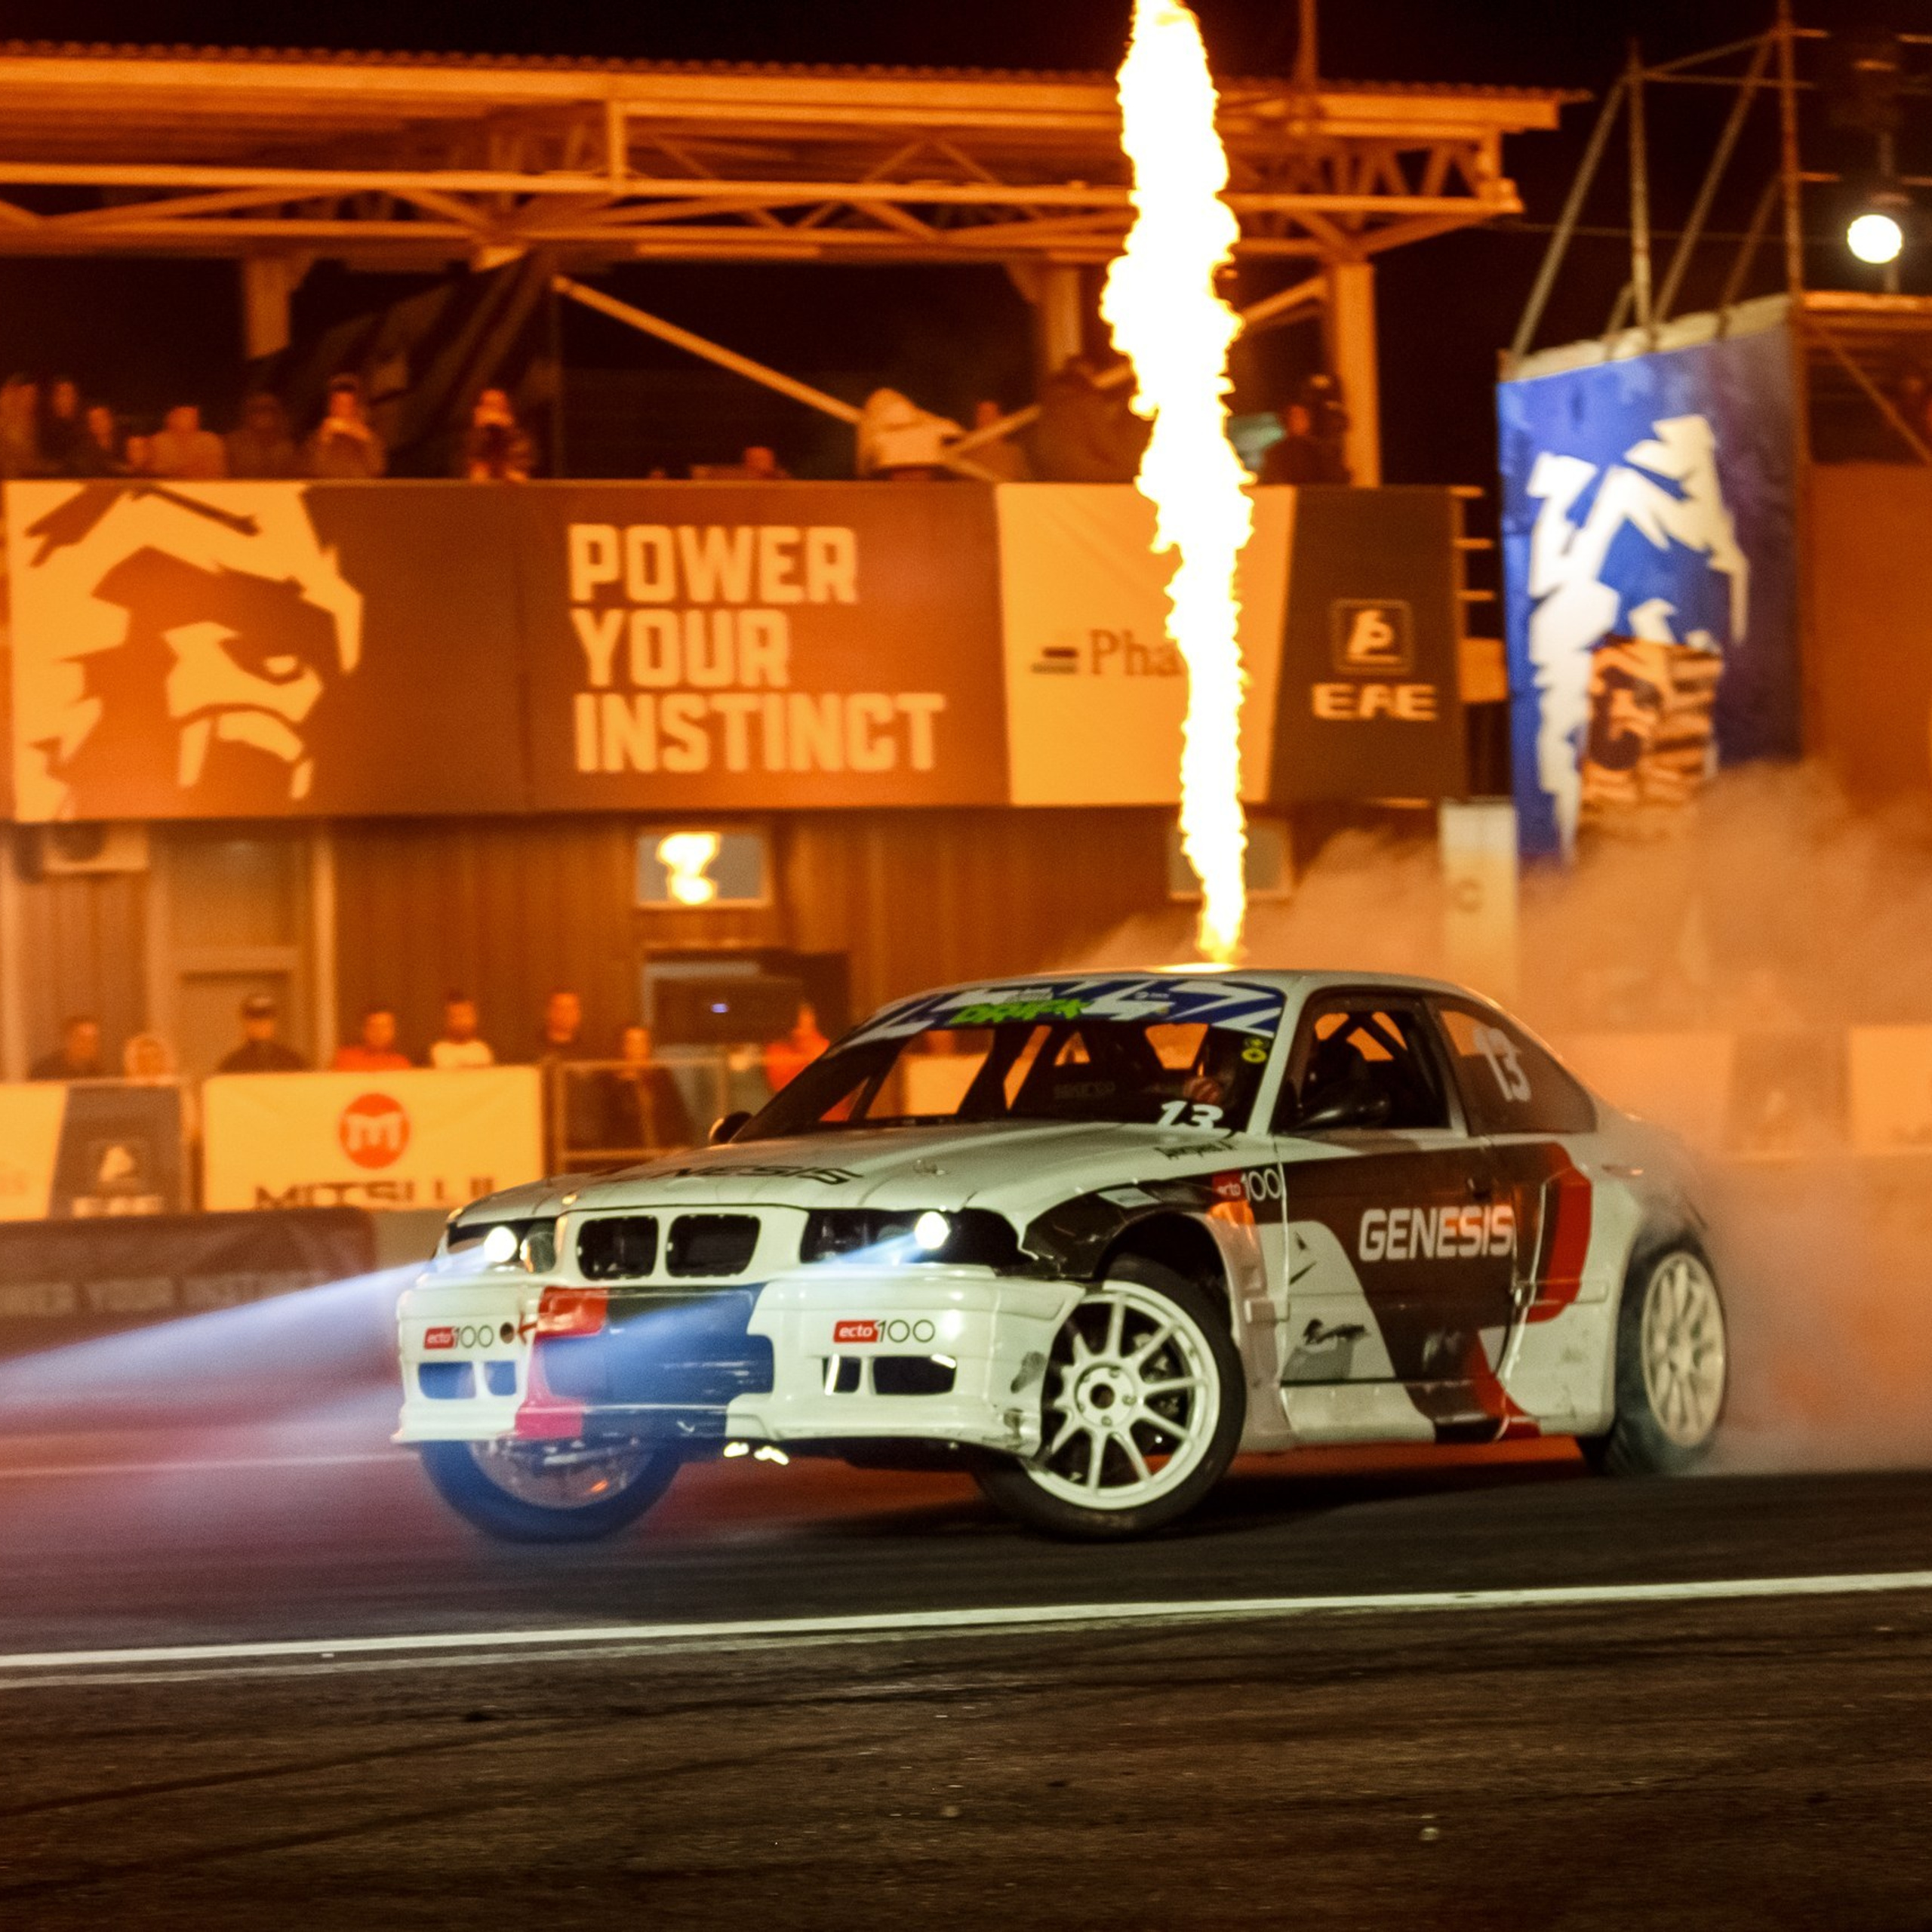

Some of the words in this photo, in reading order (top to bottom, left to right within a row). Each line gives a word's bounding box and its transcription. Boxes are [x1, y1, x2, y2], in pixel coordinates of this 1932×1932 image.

[570, 524, 857, 603] POWER
[571, 608, 789, 688] YOUR
[1091, 629, 1183, 676] Pha
[575, 692, 947, 773] INSTINCT
[1472, 1027, 1531, 1102] 13
[1157, 1101, 1224, 1129] 13
[1359, 1205, 1515, 1262] GENESIS
